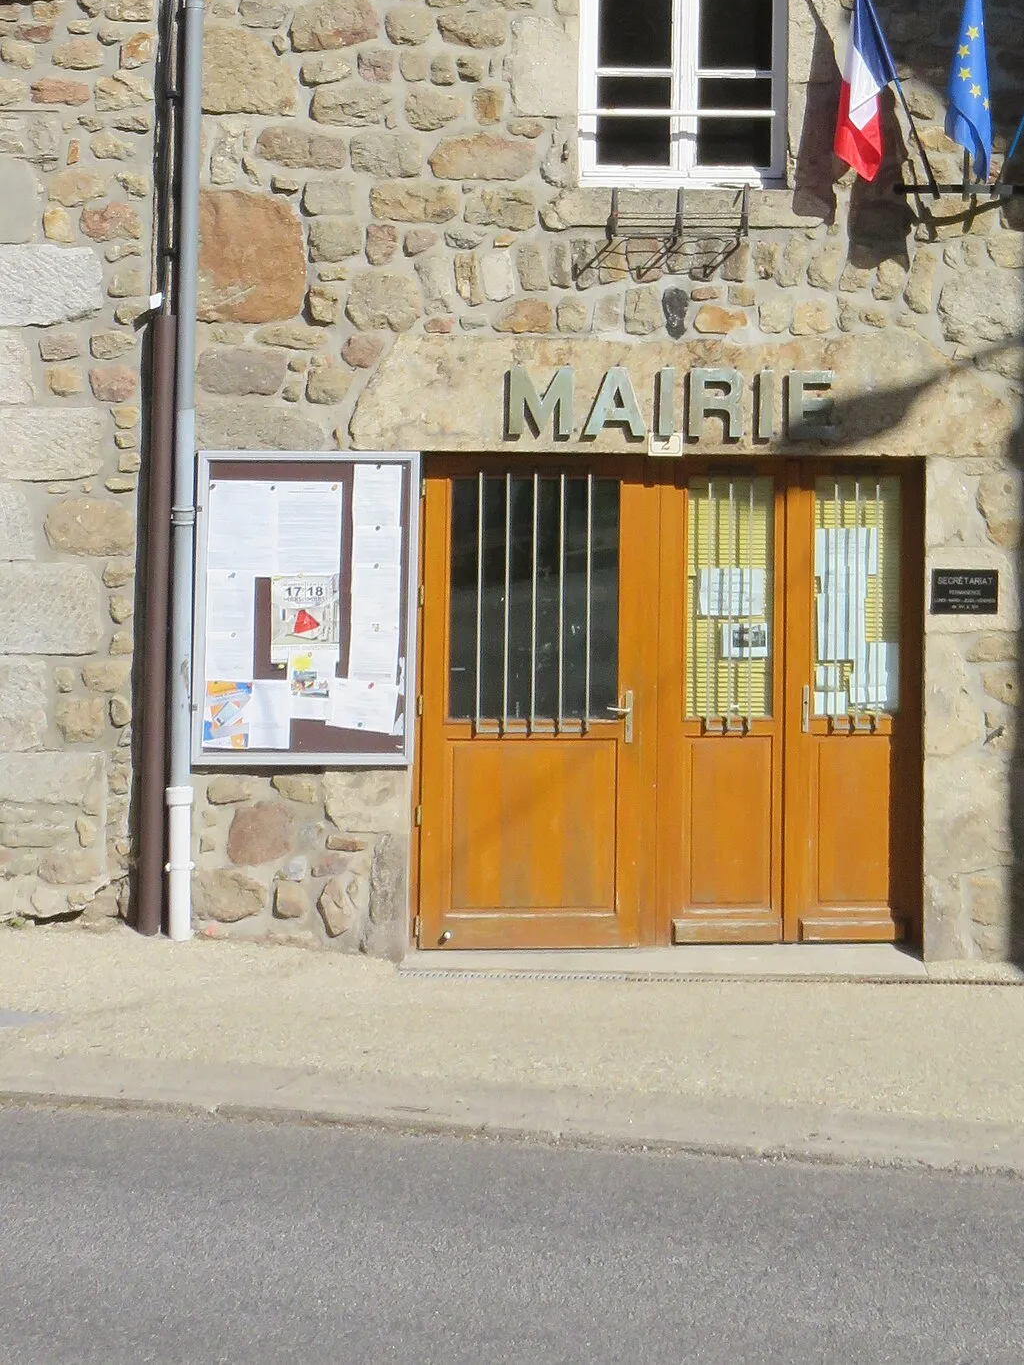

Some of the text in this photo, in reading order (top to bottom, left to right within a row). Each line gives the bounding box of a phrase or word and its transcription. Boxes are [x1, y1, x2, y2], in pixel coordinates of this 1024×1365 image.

[504, 366, 836, 440] MAIRIE
[937, 575, 993, 585] SECRÉTARIAT
[285, 586, 324, 597] 17 18
